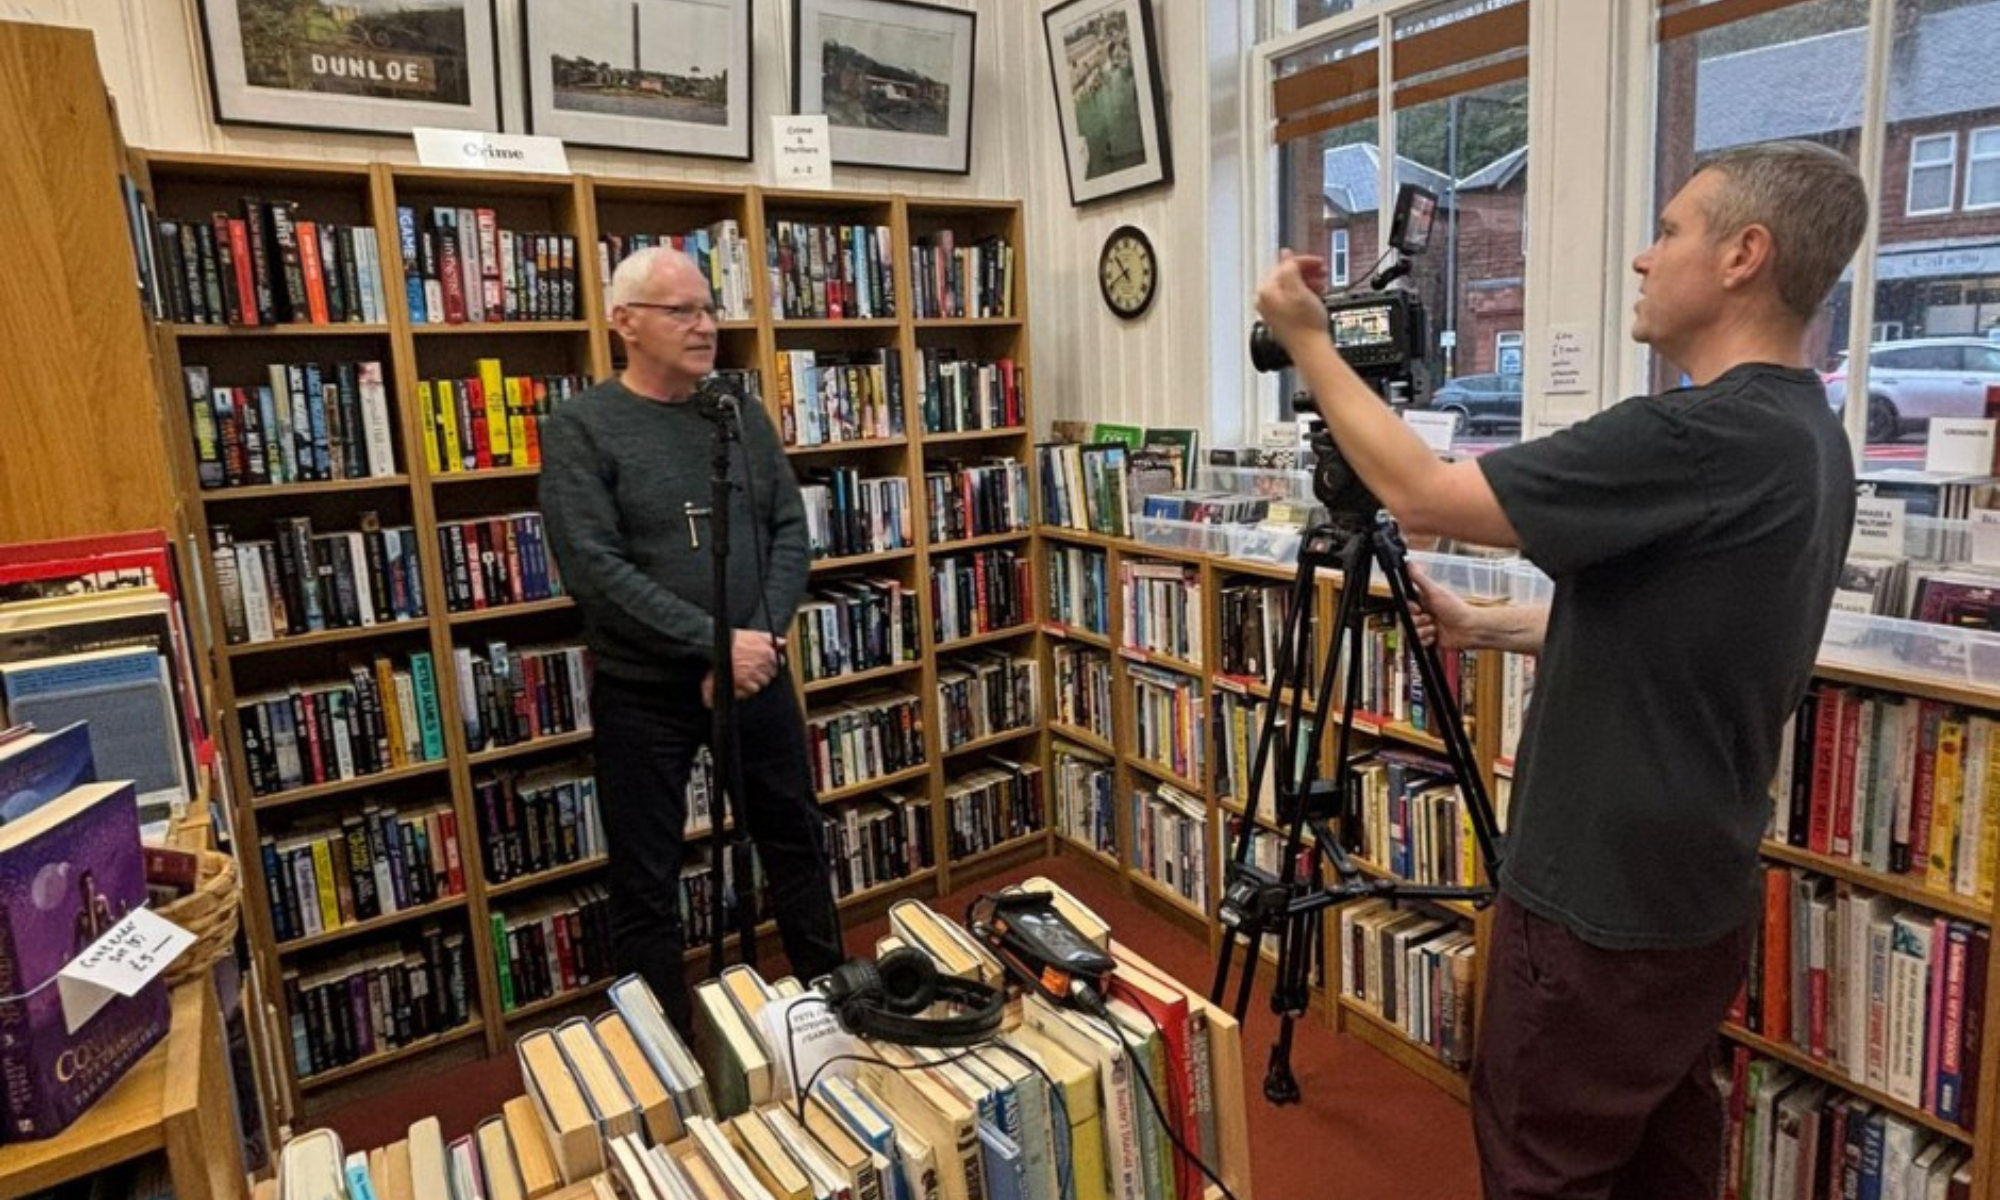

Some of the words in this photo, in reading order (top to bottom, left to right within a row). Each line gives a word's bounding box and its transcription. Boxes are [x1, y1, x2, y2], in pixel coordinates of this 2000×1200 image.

[311, 53, 419, 82] DUNLOE
[787, 126, 813, 135] Crime
[463, 142, 524, 160] Crime
